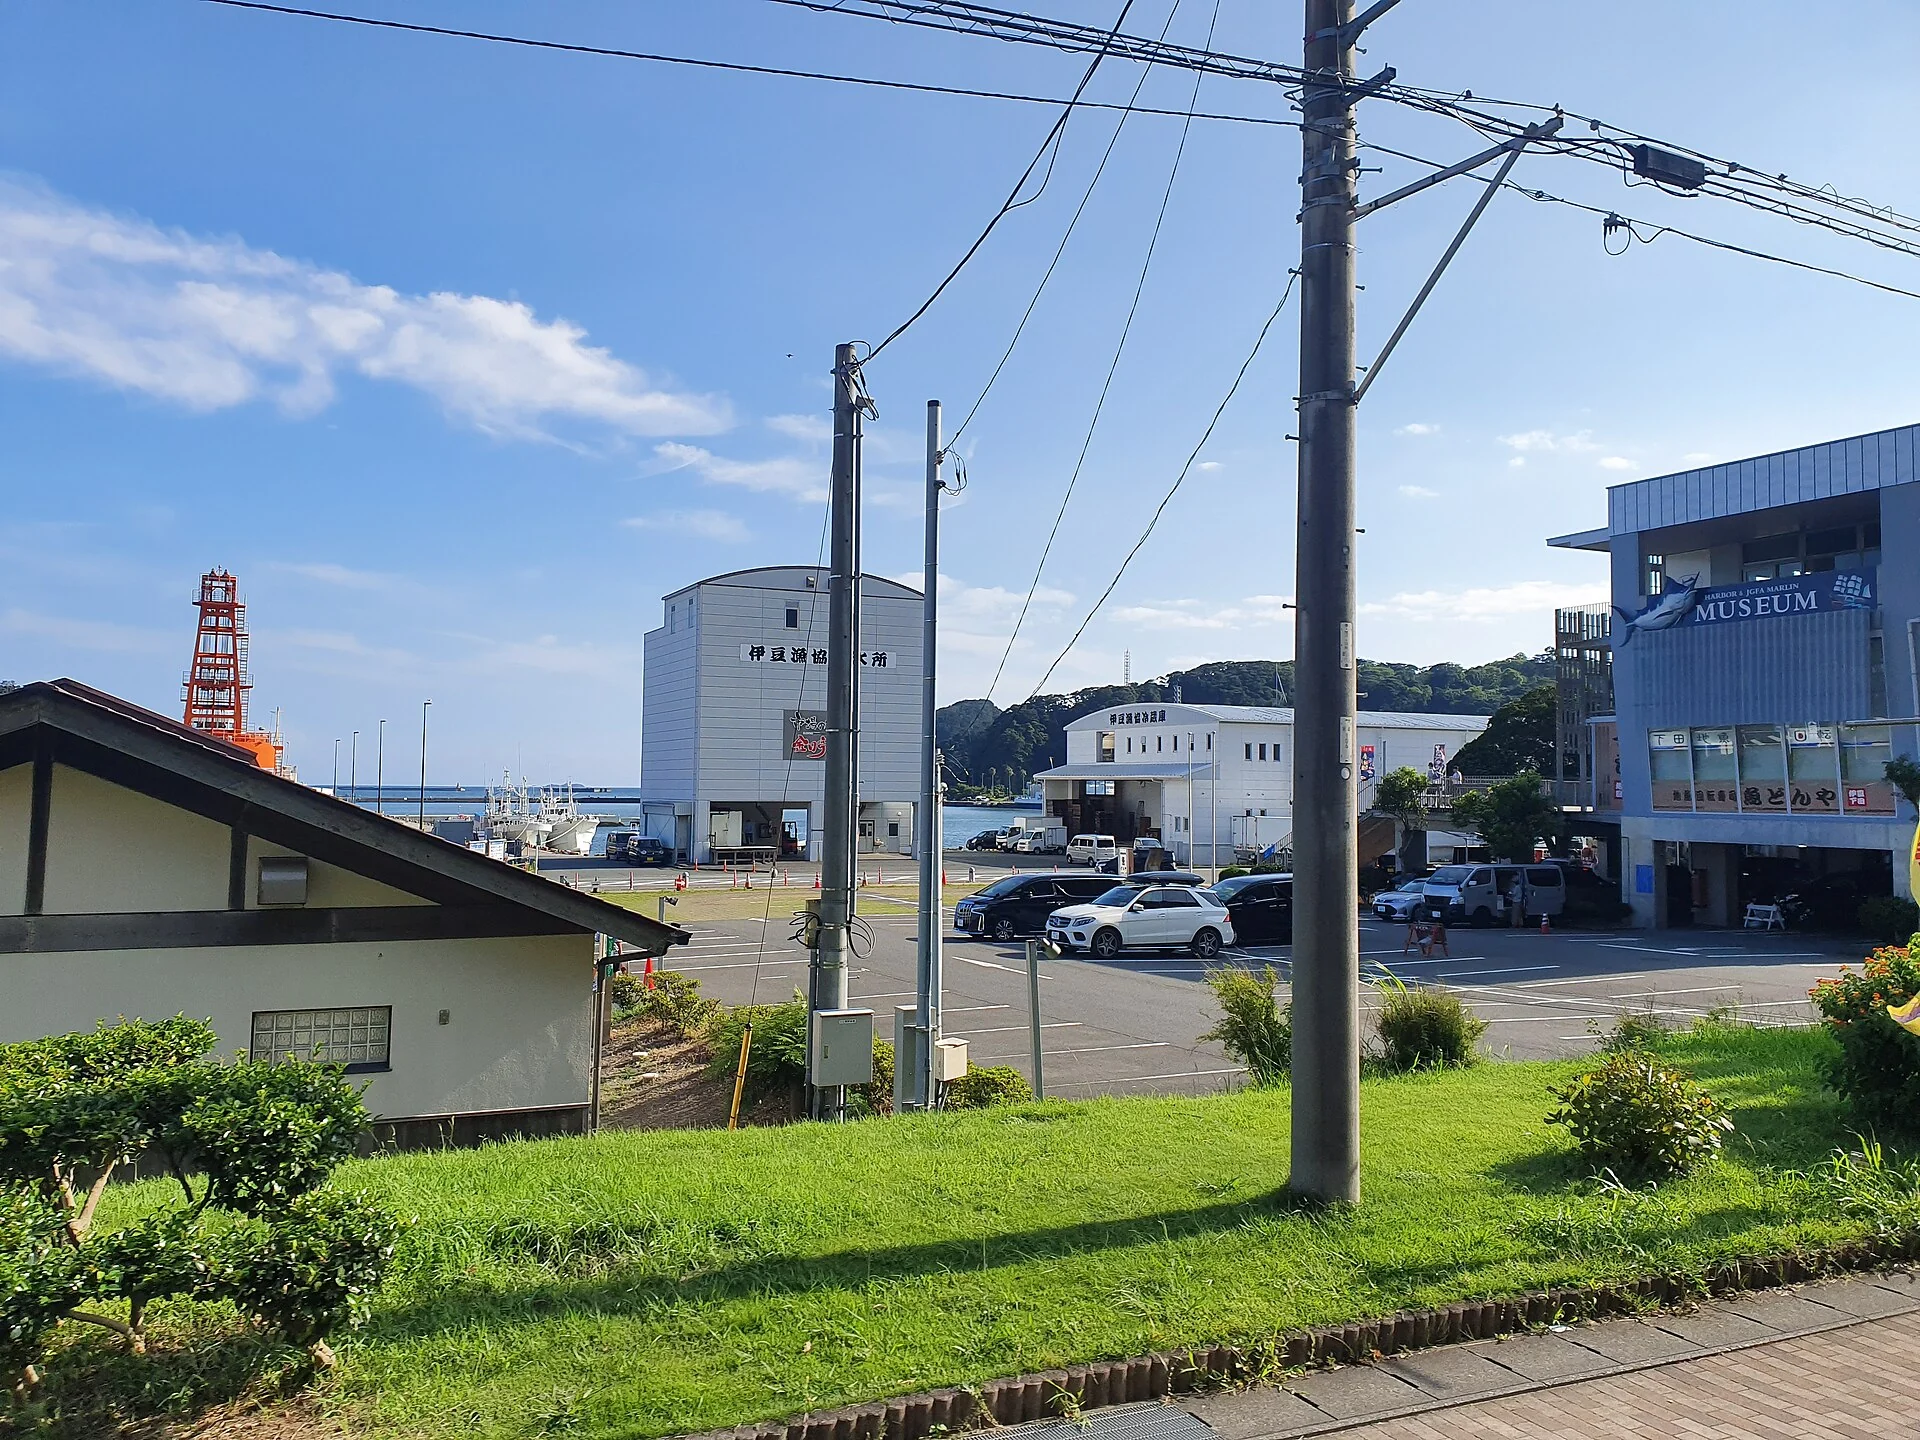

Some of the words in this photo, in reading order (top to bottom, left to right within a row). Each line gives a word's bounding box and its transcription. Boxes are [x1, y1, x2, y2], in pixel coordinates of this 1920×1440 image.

[1704, 590, 1737, 600] HARBOR
[1746, 588, 1765, 597] JGFA
[1766, 583, 1800, 593] MARLIN
[1694, 590, 1818, 622] MUSEUM
[748, 644, 888, 668] 伊豆漁協所
